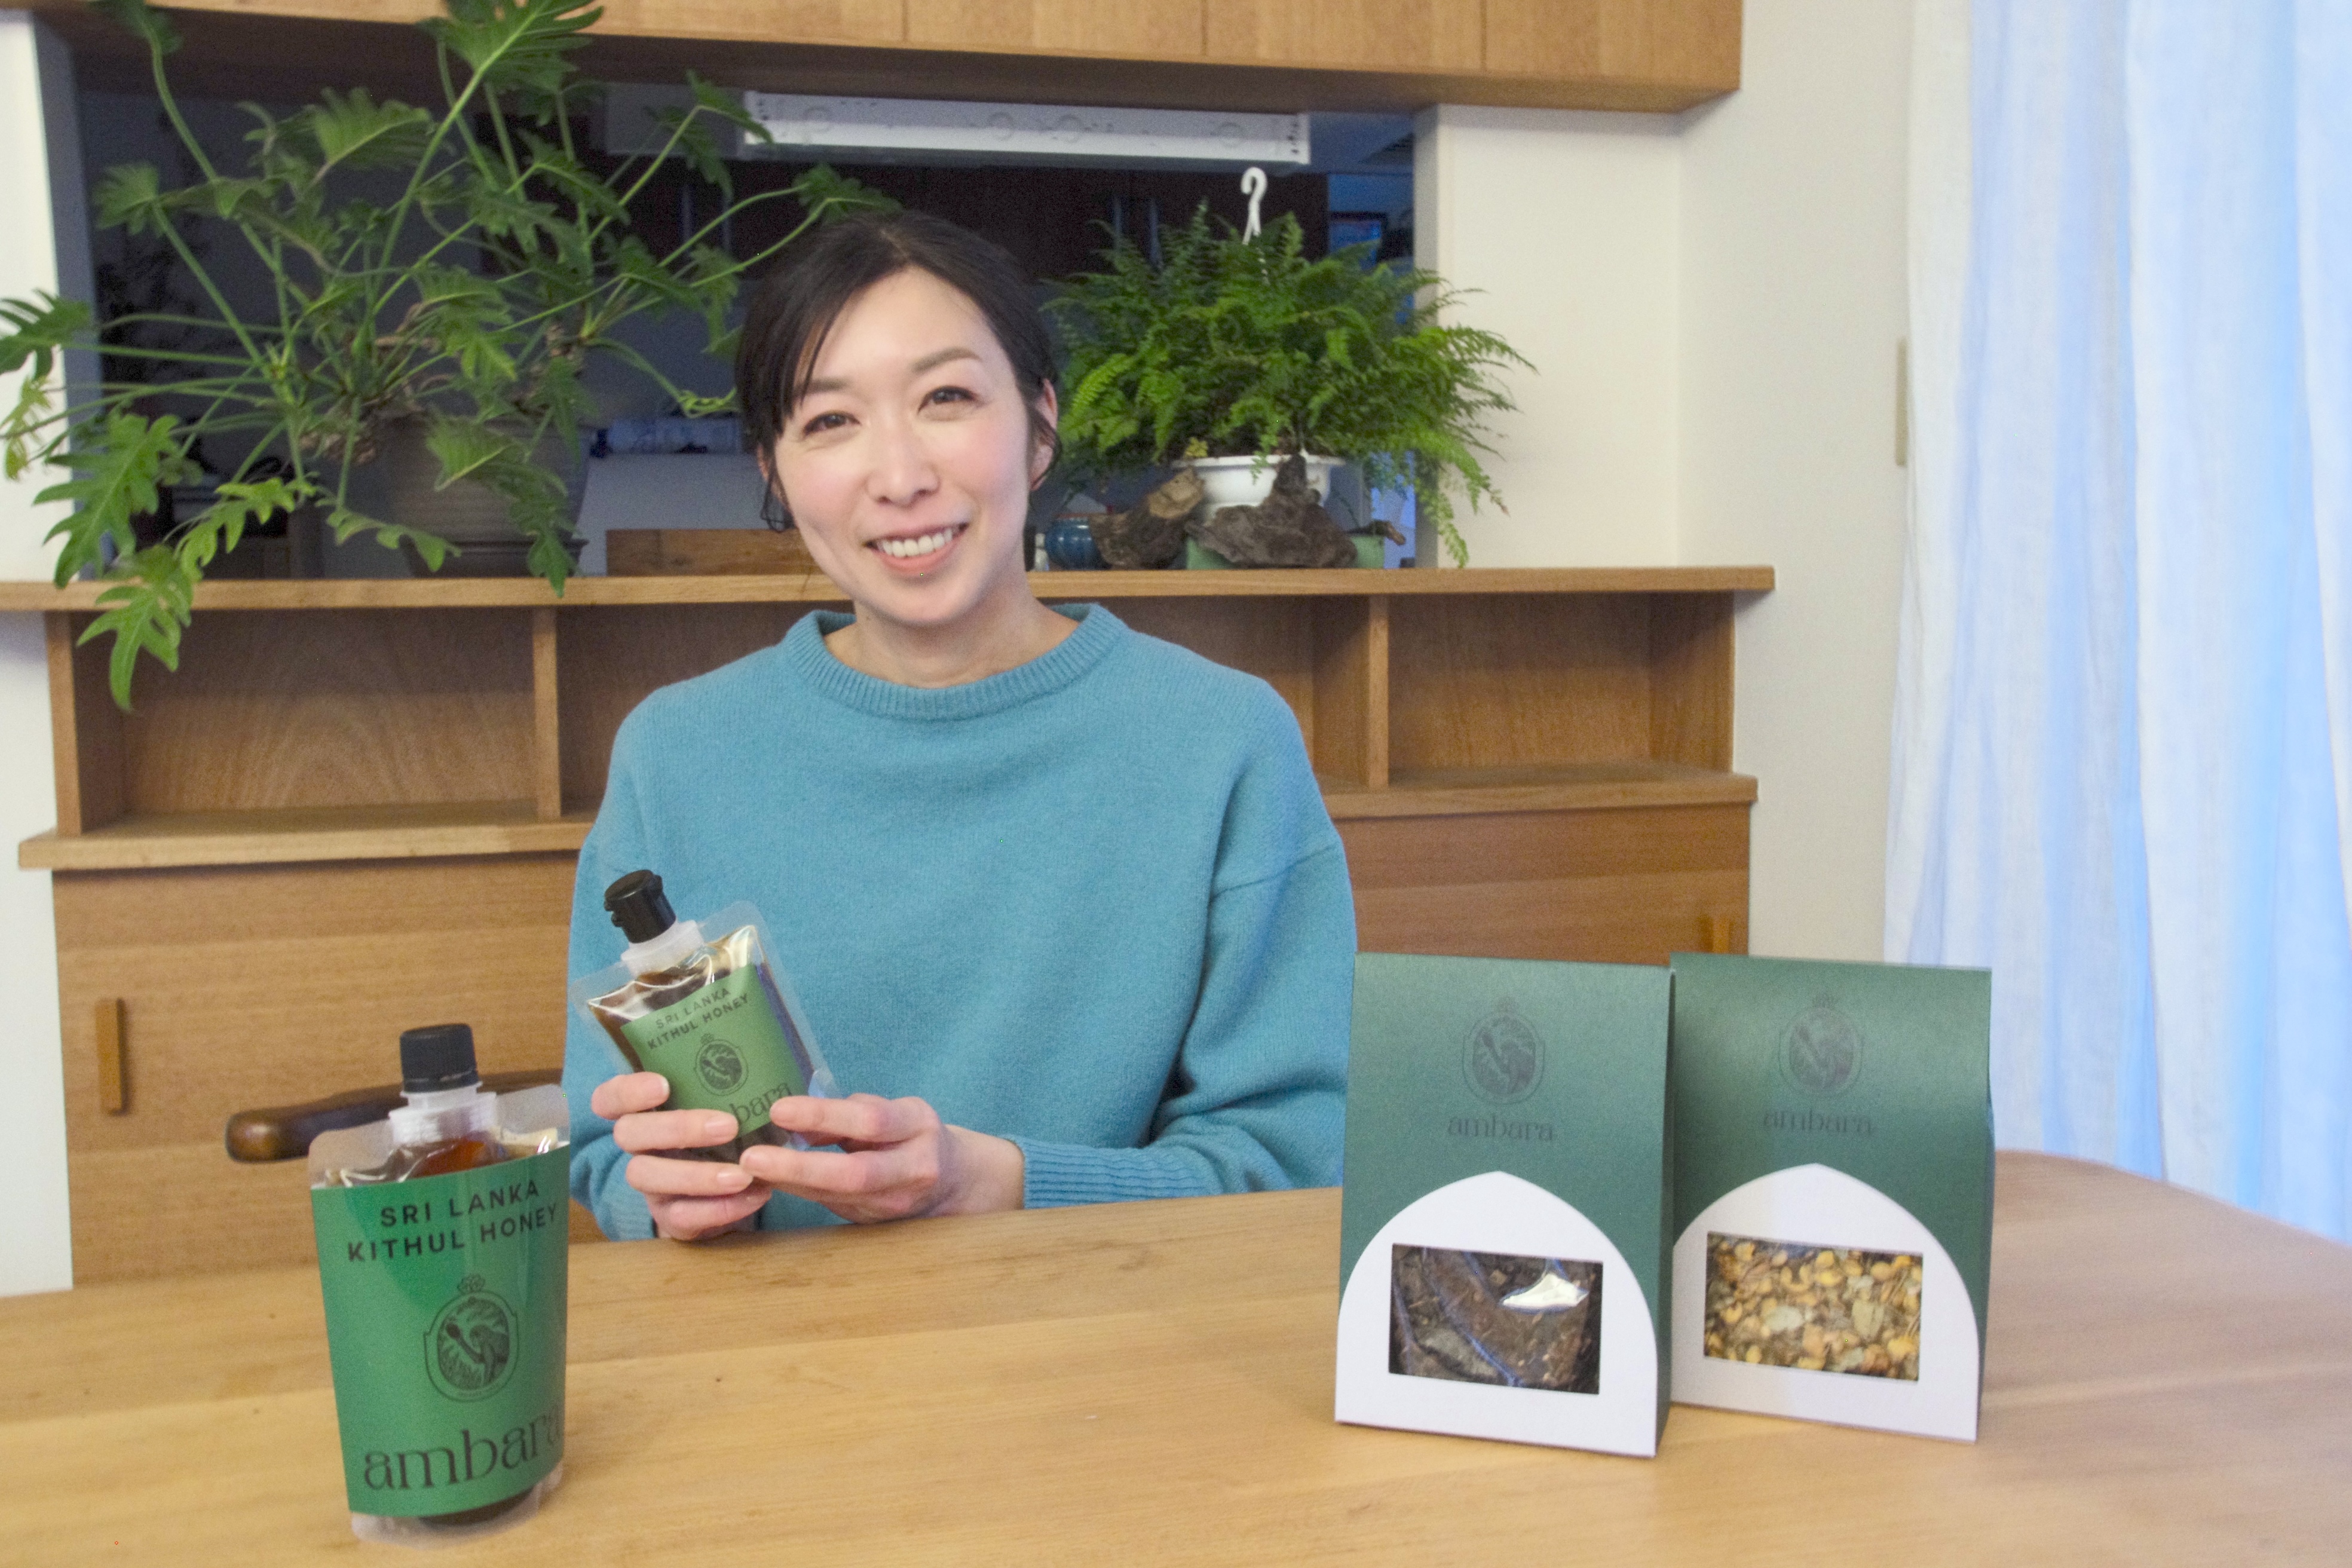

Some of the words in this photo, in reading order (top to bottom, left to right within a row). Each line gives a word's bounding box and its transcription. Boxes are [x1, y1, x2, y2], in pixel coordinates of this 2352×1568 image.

[647, 1021, 699, 1049] KITHUL
[703, 993, 749, 1024] HONEY
[656, 1010, 680, 1028] SRI
[684, 987, 731, 1015] LANKA
[1448, 1115, 1553, 1141] ambara
[1763, 1108, 1871, 1134] ambara
[380, 1202, 431, 1227] SRI
[449, 1180, 538, 1218] LANKA
[347, 1230, 466, 1262] KITHUL
[480, 1202, 558, 1244] HONEY
